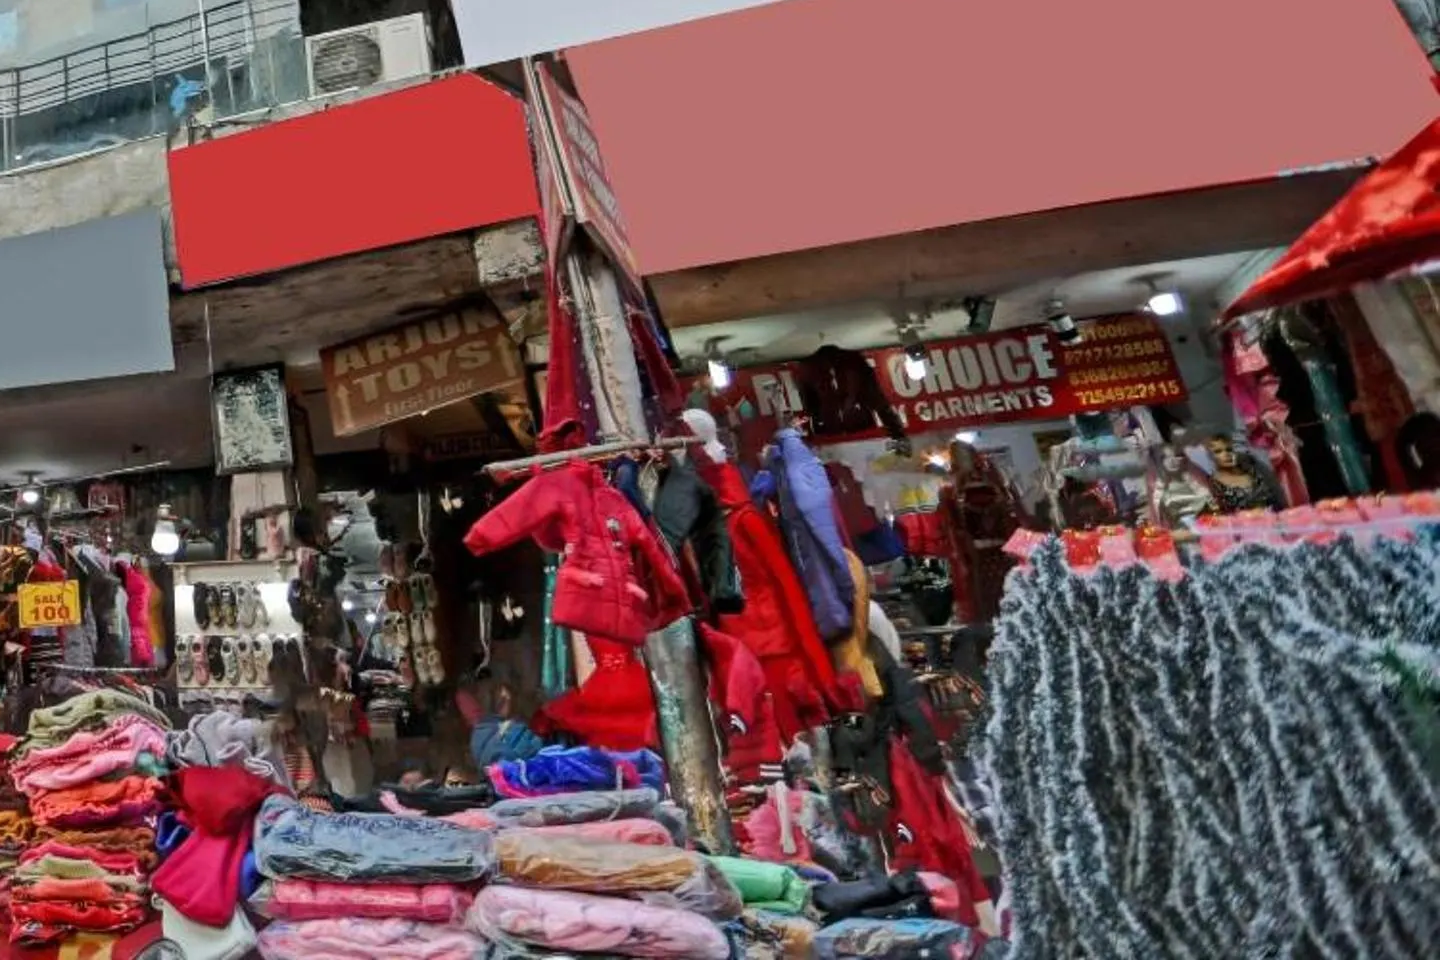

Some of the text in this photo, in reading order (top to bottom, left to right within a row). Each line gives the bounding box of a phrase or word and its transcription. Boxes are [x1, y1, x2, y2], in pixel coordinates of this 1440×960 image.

[353, 339, 492, 403] TOYS
[886, 334, 1058, 397] CHOICE
[915, 385, 1054, 421] GARMENTS
[31, 604, 70, 622] 100
